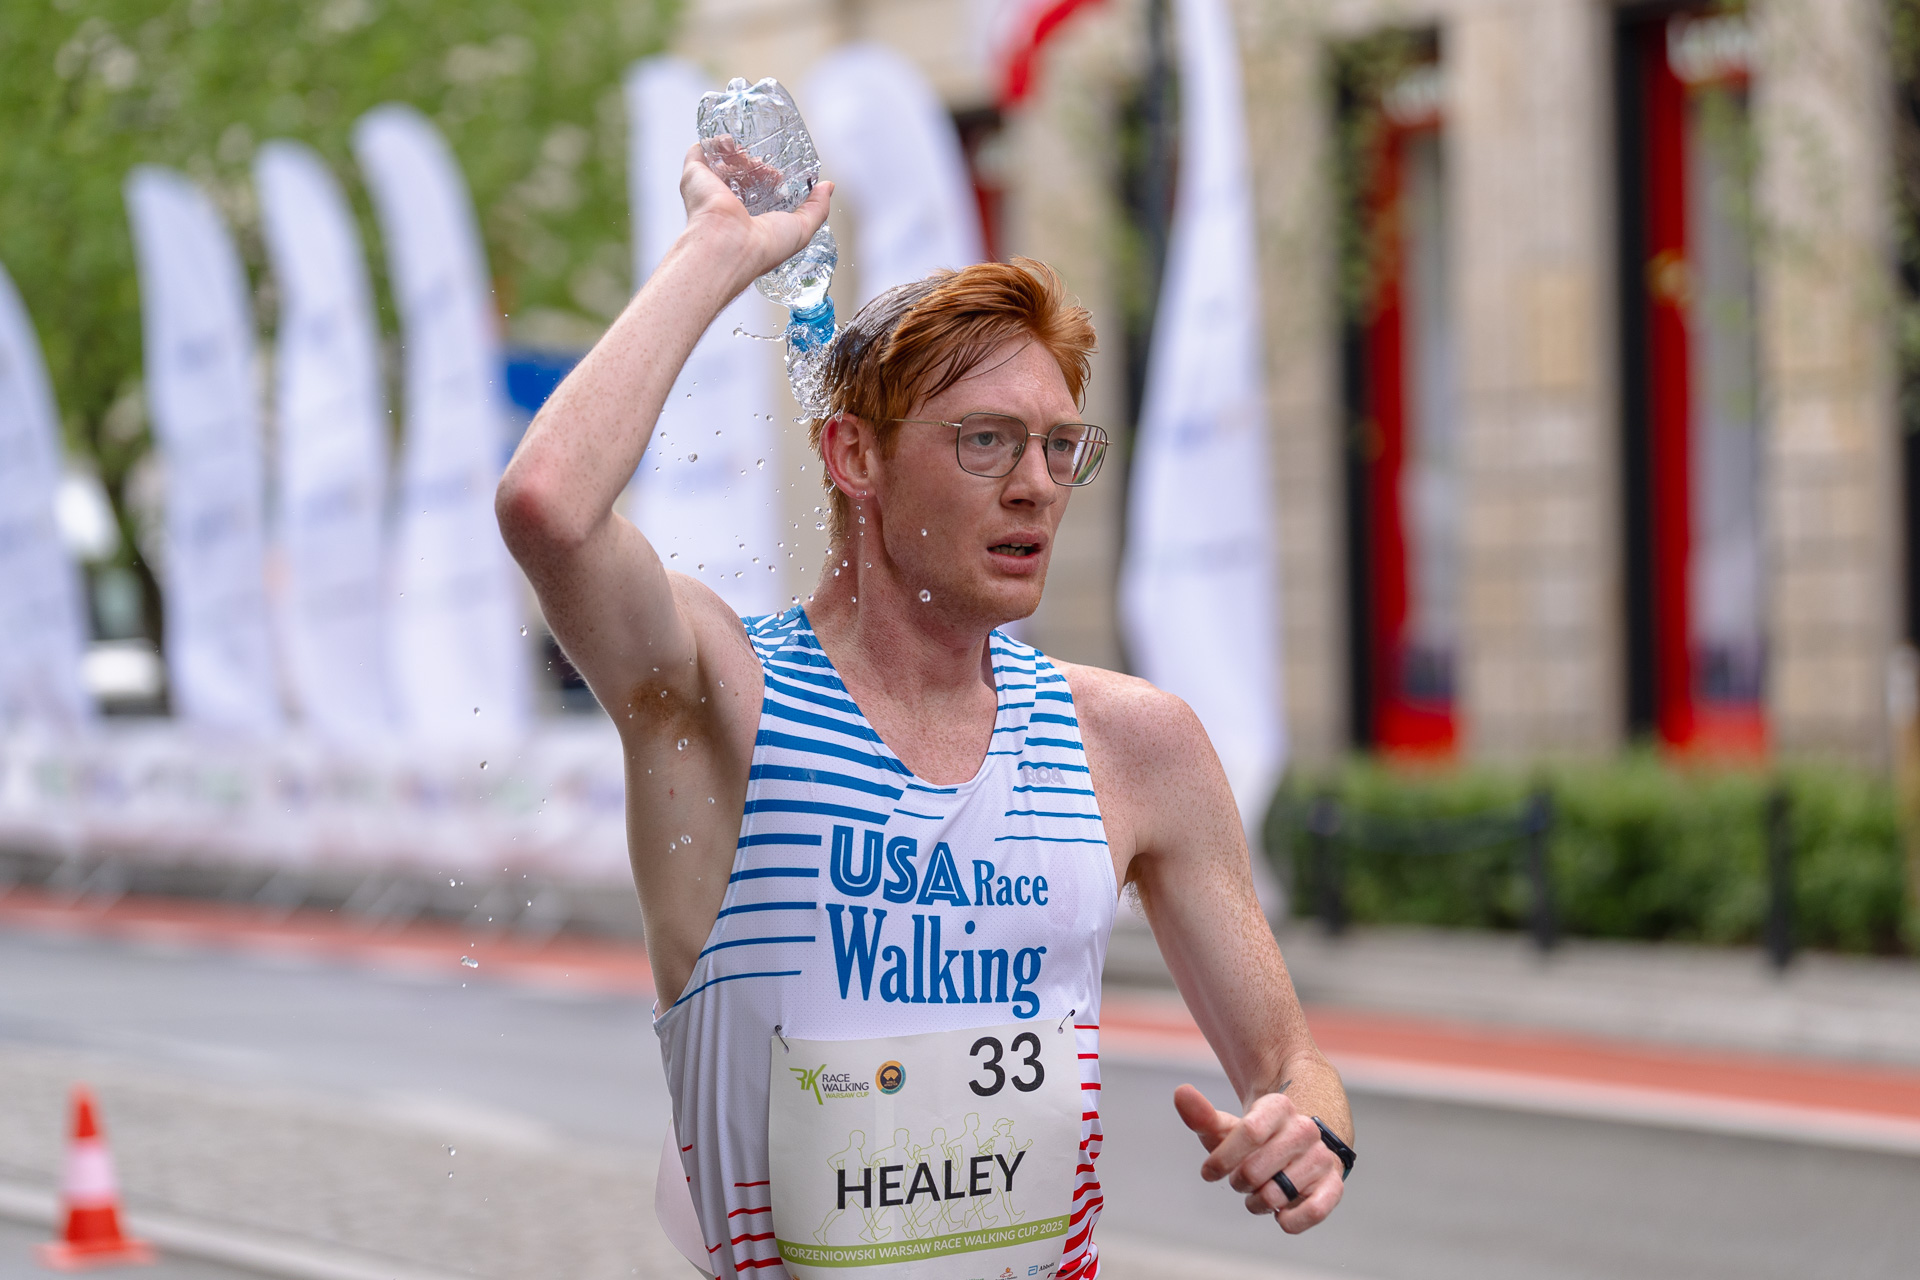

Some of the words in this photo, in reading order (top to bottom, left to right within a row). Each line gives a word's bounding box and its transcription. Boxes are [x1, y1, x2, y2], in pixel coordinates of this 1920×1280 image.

[830, 824, 971, 907] USA
[972, 860, 1049, 906] Race
[825, 903, 1047, 1019] Walking
[822, 1073, 850, 1083] RACE
[822, 1082, 869, 1092] WALKING
[968, 1031, 1045, 1097] 33
[837, 1150, 1026, 1210] HEALEY
[783, 1245, 876, 1261] KORZENIOWSKI
[878, 1242, 932, 1258] WARSAW
[934, 1238, 961, 1251] RACE
[964, 1230, 1015, 1246] WALKING
[1017, 1226, 1038, 1238] CUP
[1040, 1221, 1063, 1234] 2025
